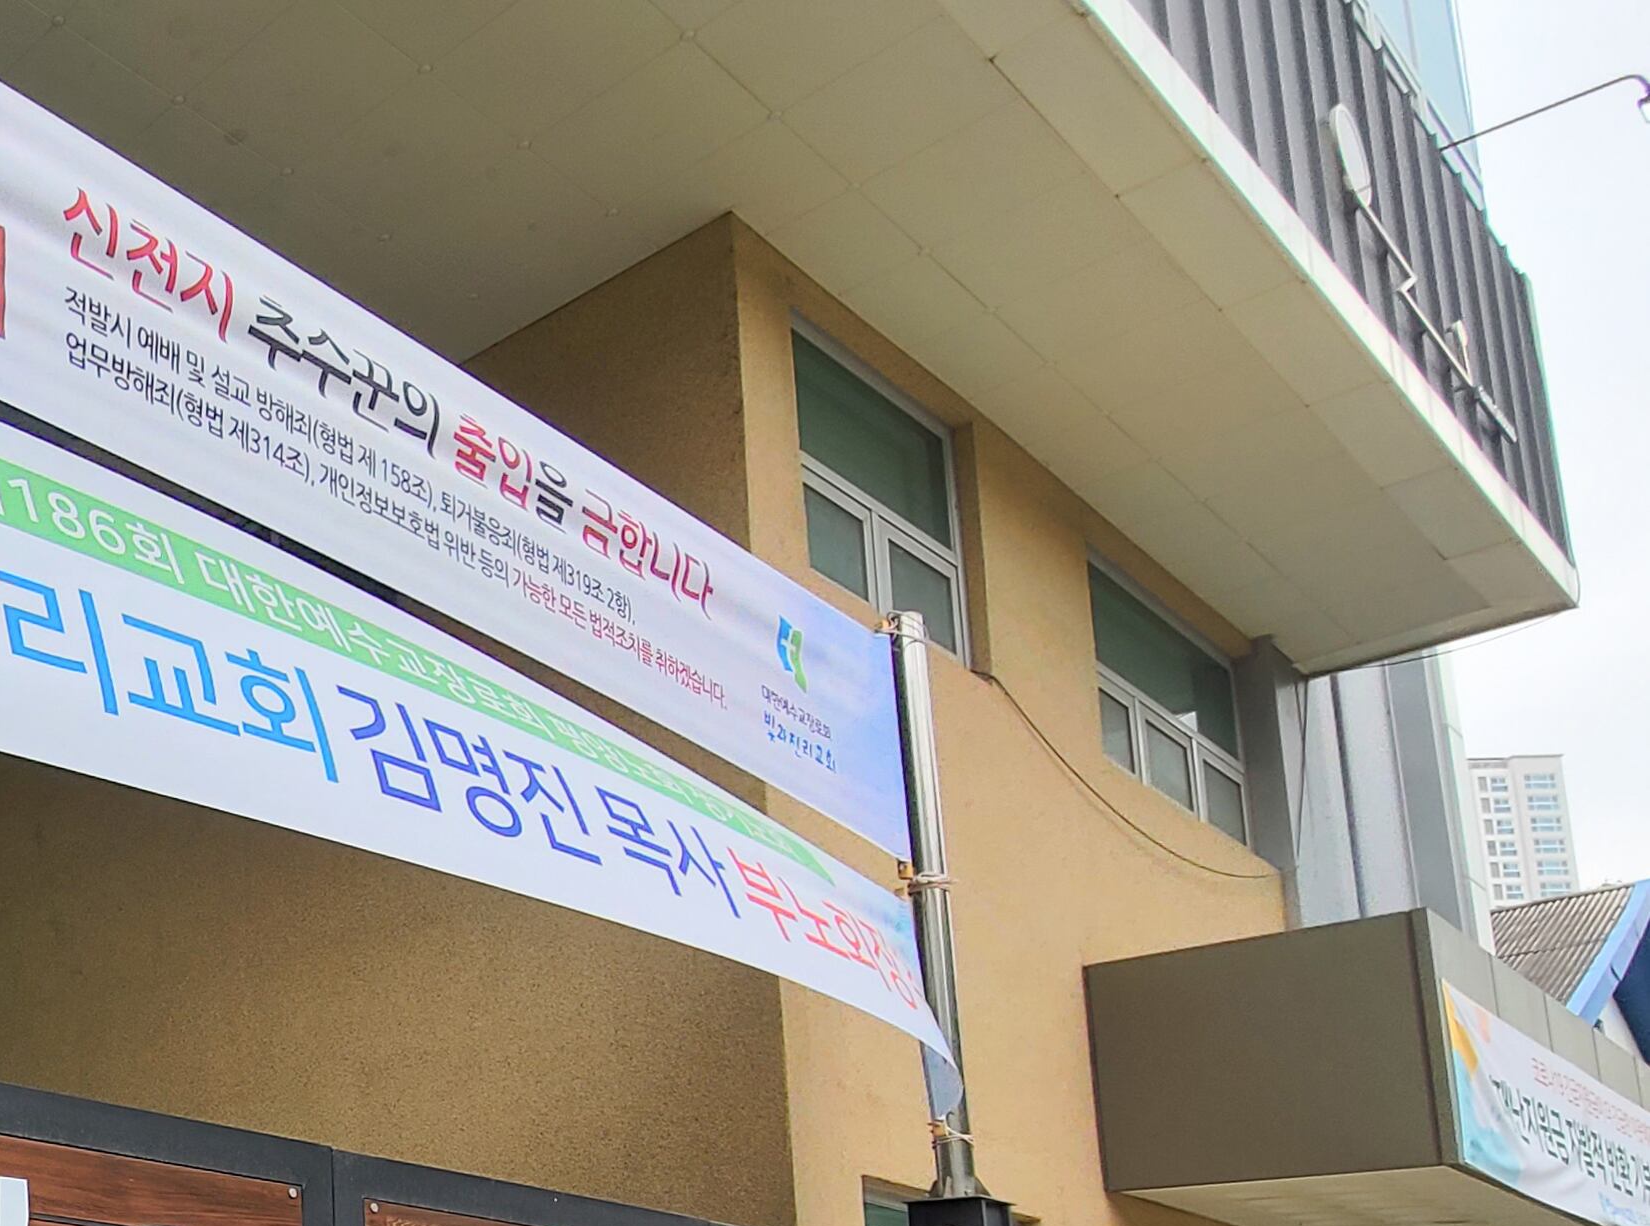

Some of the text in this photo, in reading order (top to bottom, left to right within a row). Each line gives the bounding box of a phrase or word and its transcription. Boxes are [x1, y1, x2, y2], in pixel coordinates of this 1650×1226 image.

[63, 188, 714, 620] 신천지 추수꾼의 출입을 금합니다
[65, 286, 132, 350] 적발시
[138, 327, 180, 375] 예배
[186, 352, 206, 388] 및
[212, 366, 250, 405] 설교
[256, 387, 353, 465] 방해죄(형법
[359, 444, 376, 478] 제
[440, 493, 550, 573] 퇴거불응죄(형법
[552, 551, 605, 603] 제319조
[65, 332, 223, 439] 업무방해죄(형법
[320, 464, 440, 548] 개인정보보호법
[444, 530, 477, 568] 위반
[480, 557, 510, 589] 등의
[513, 567, 557, 612] 가능한
[559, 595, 587, 628] 모든
[589, 608, 654, 668] 법적조치를
[656, 648, 728, 711] 취하겠습니다.
[195, 550, 555, 741] 대한예수교장로회
[763, 710, 837, 773] 빛과진리교회
[337, 684, 603, 866] 김명진
[595, 784, 742, 920] 목사
